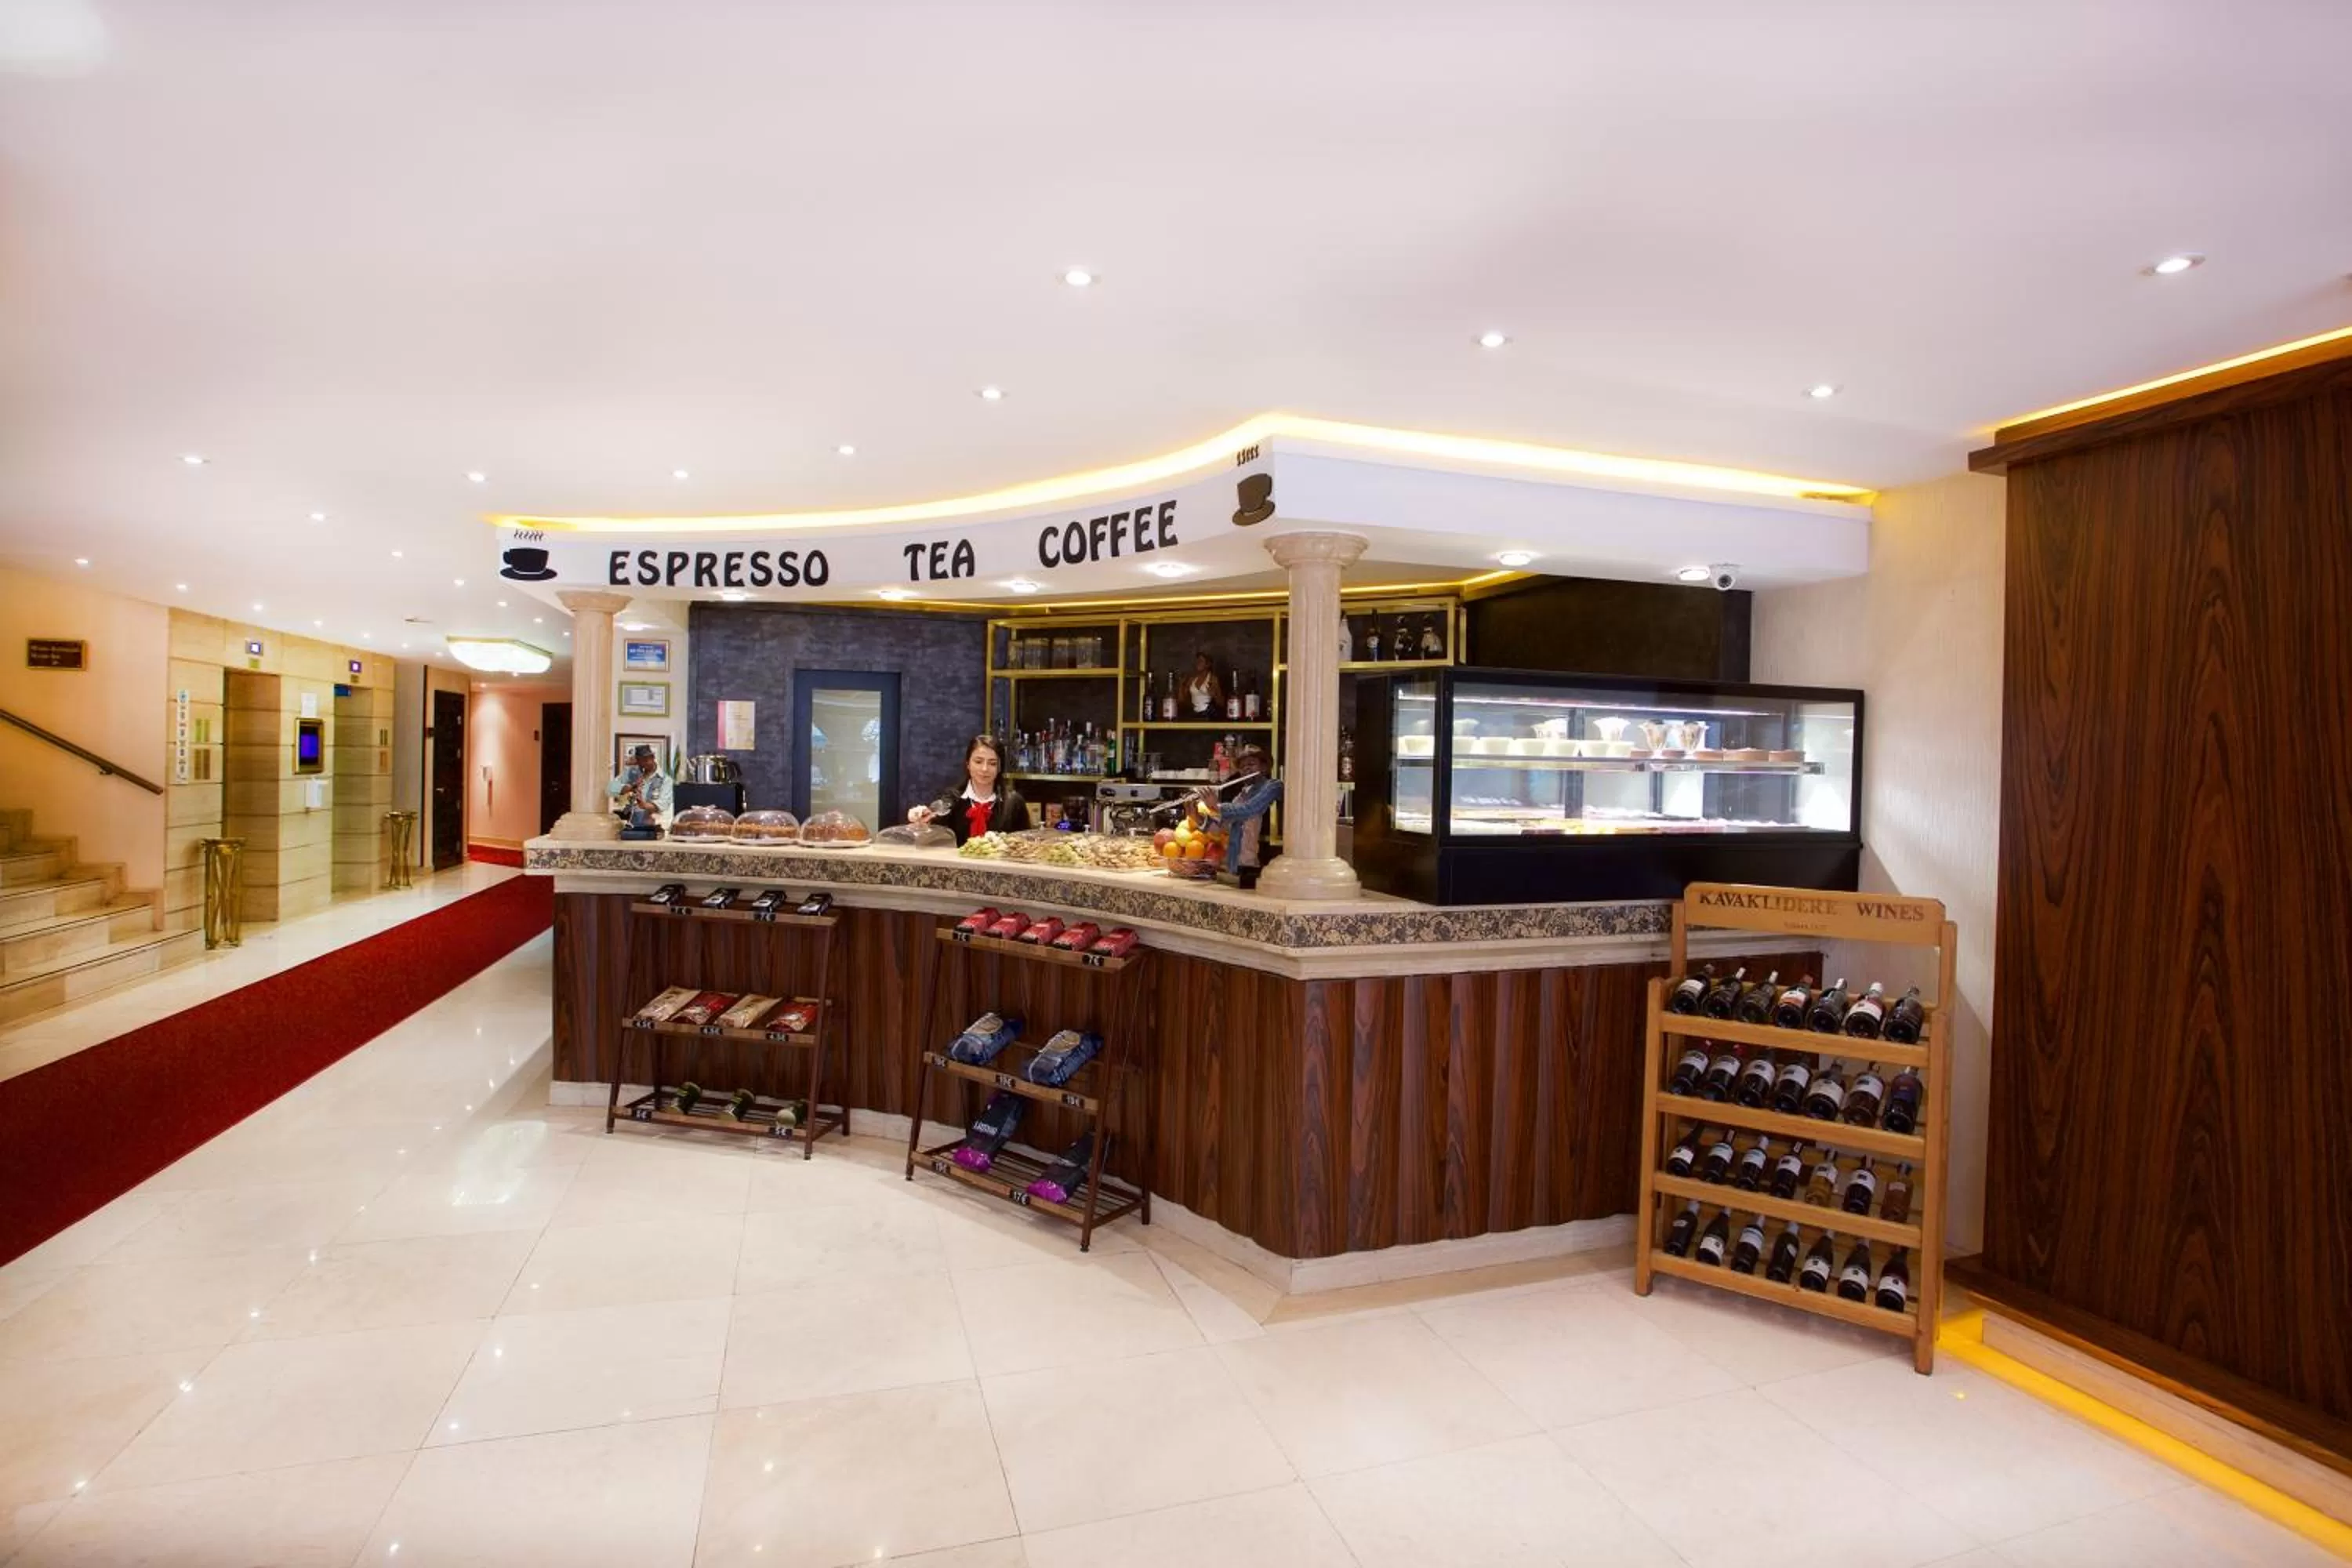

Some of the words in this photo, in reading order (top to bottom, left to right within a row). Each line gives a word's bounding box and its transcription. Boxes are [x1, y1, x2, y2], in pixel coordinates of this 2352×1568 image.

[609, 550, 829, 587] ESPRESSO
[903, 539, 975, 581] TEA
[1038, 499, 1179, 568] COFFEE
[1857, 902, 1925, 922] WINES
